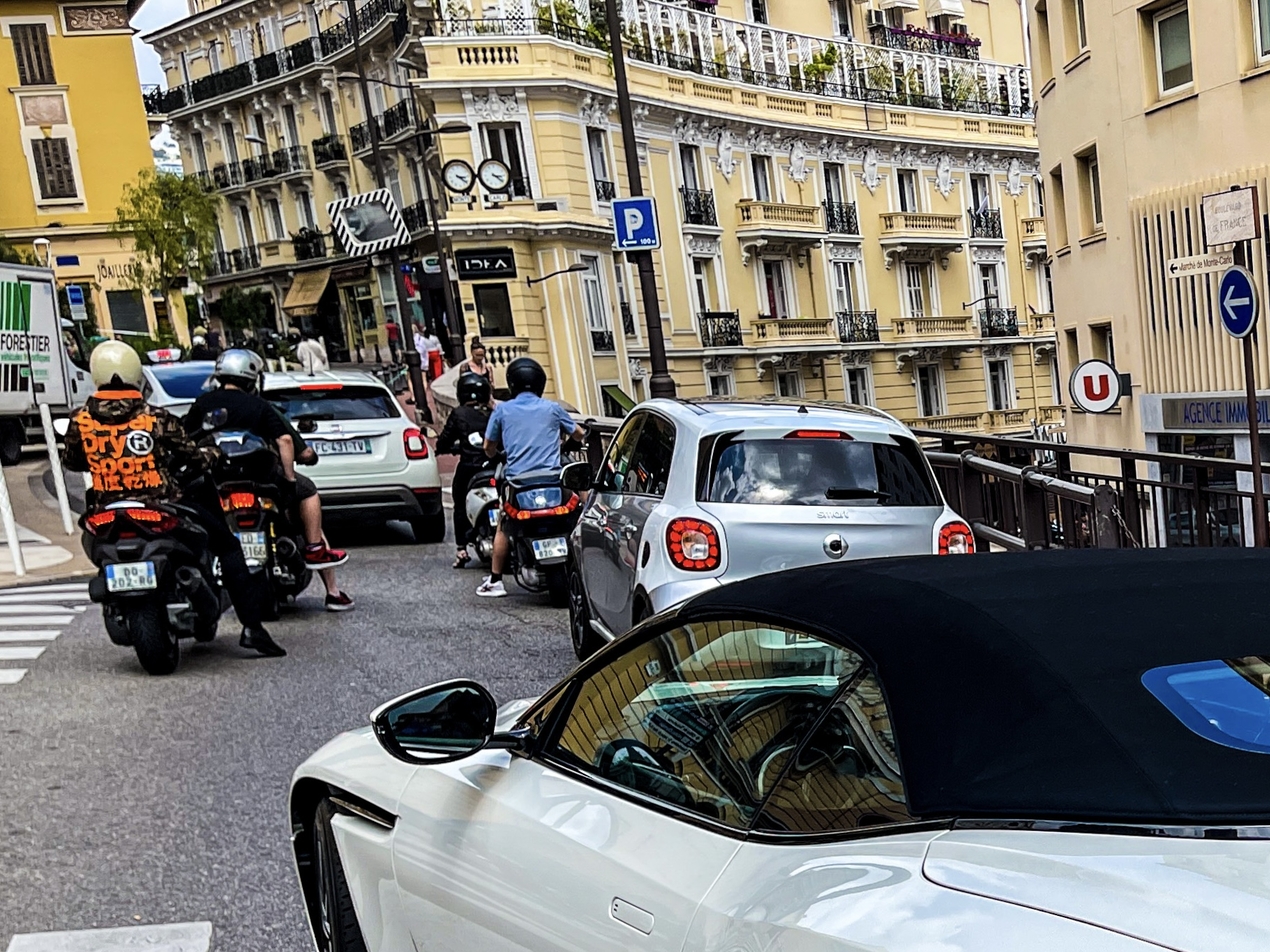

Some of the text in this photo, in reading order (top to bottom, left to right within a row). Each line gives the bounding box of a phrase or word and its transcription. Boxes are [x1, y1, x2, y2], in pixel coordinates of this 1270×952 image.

[624, 208, 644, 240] P
[1083, 374, 1109, 401] U
[1183, 401, 1222, 424] AGENCE
